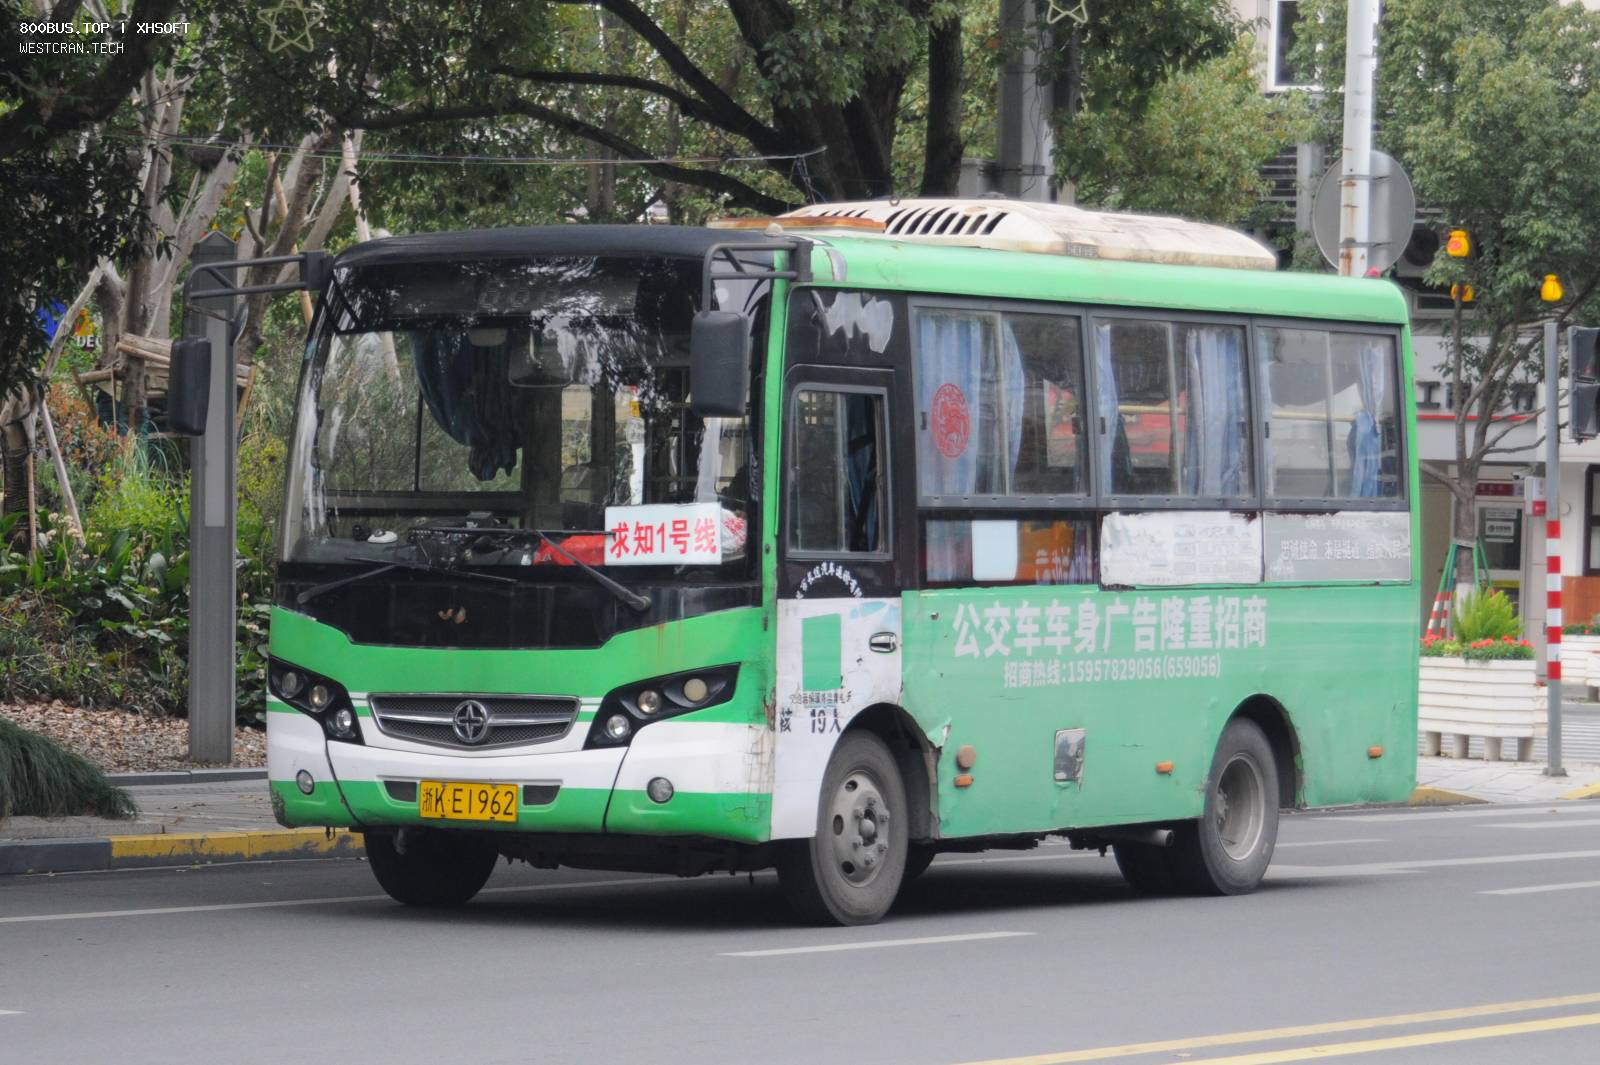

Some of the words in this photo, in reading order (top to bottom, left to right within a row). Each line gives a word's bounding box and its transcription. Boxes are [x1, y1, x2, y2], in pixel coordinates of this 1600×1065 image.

[610, 518, 717, 559] 求知1号线
[953, 596, 1268, 658] 公交车车身广告隆重招商
